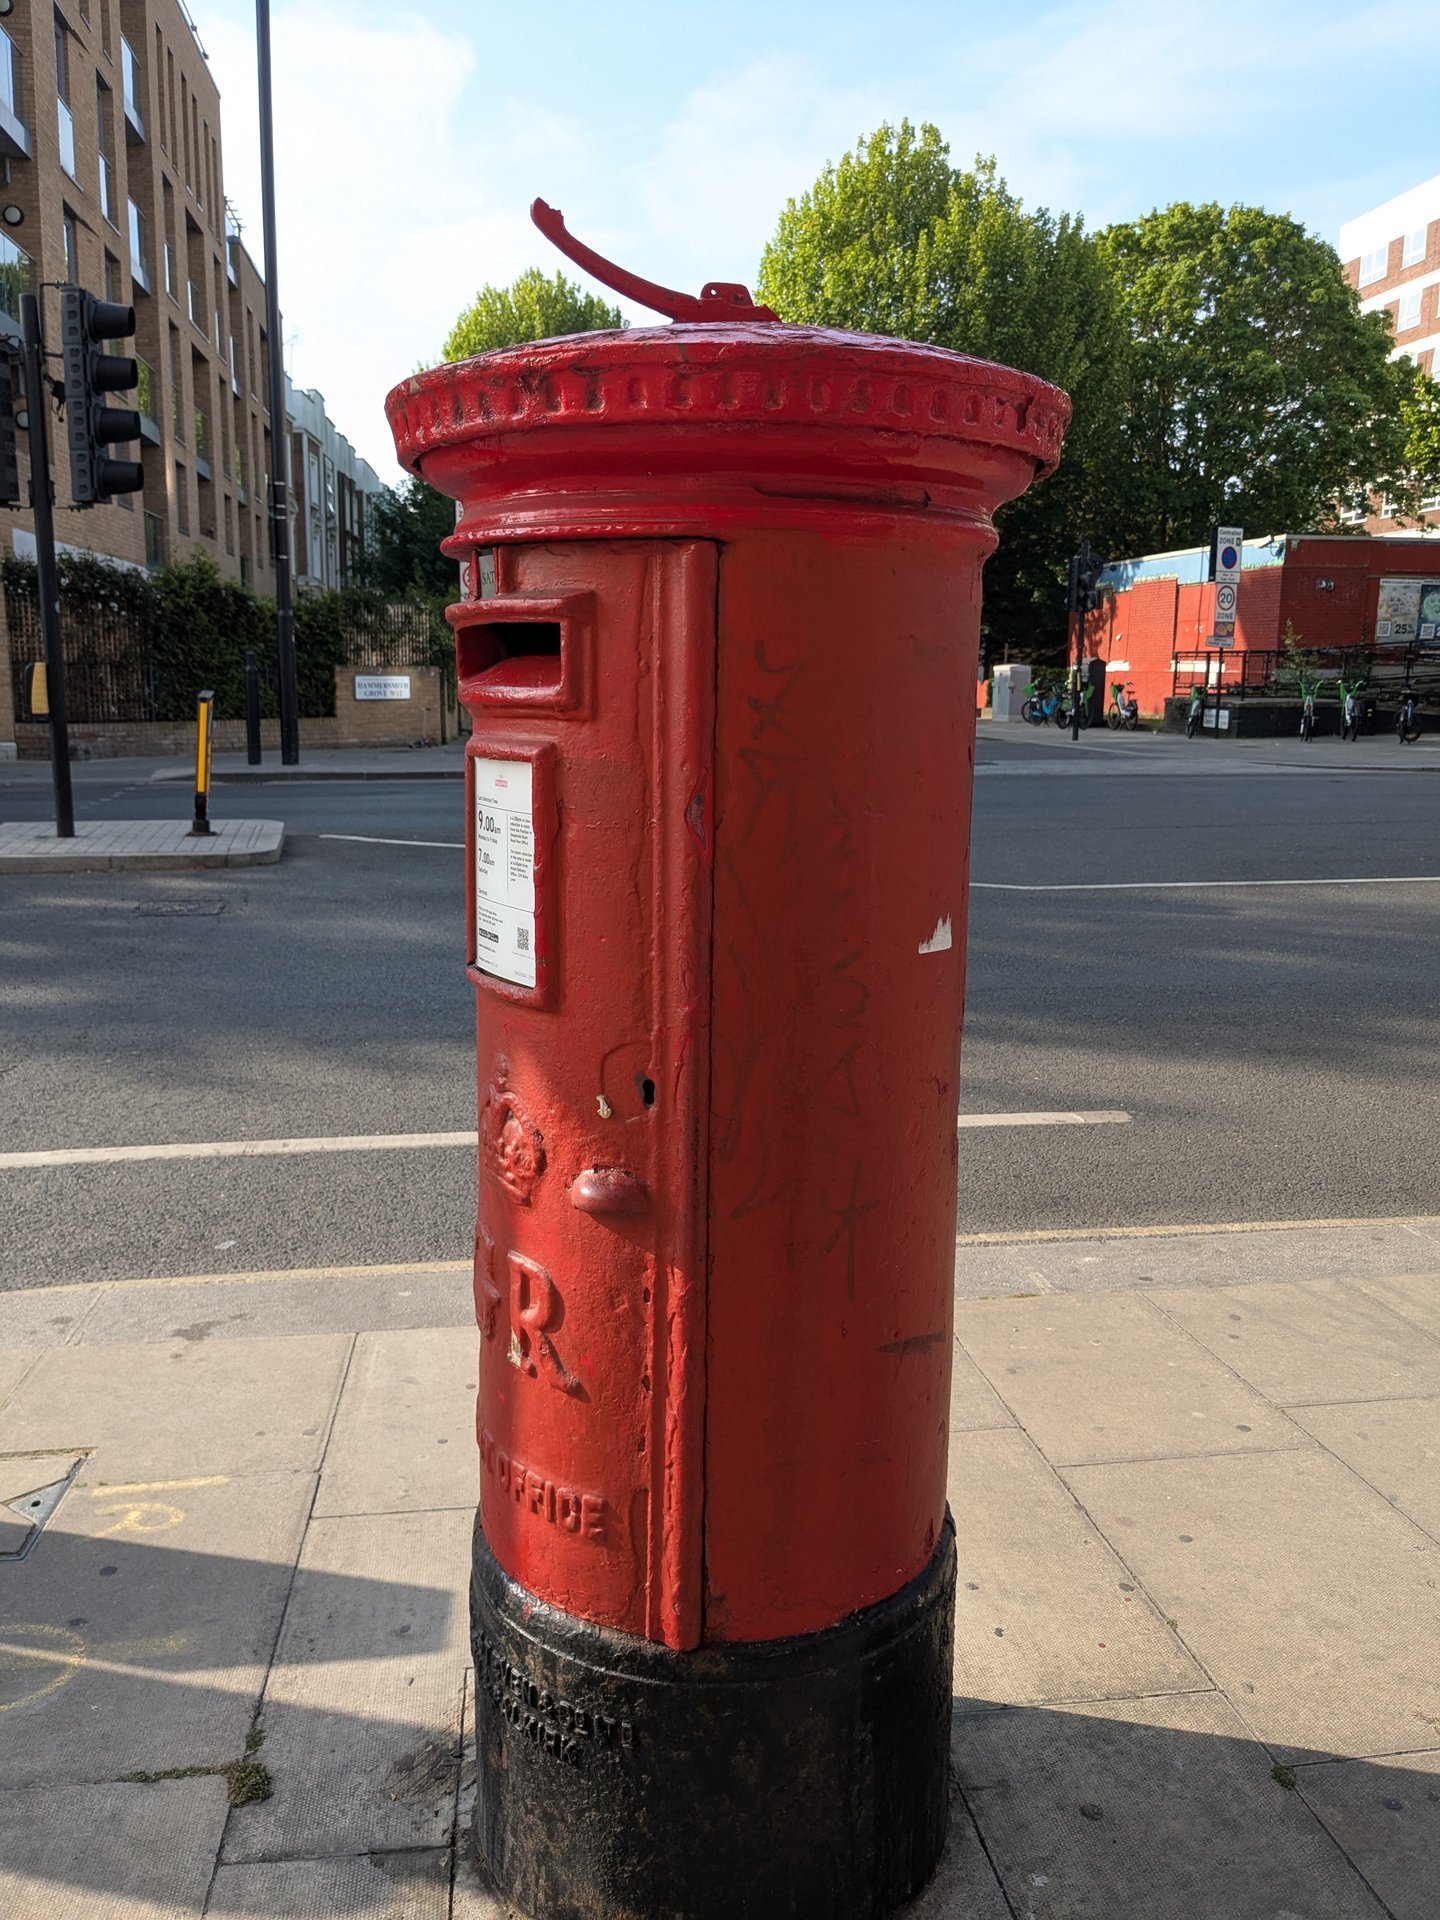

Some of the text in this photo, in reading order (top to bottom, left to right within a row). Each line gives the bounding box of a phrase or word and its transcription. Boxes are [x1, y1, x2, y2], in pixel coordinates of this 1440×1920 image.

[1219, 537, 1235, 545] ZONE
[481, 570, 496, 586] SAT
[1220, 592, 1233, 604] 20
[1217, 612, 1233, 620] ZONE
